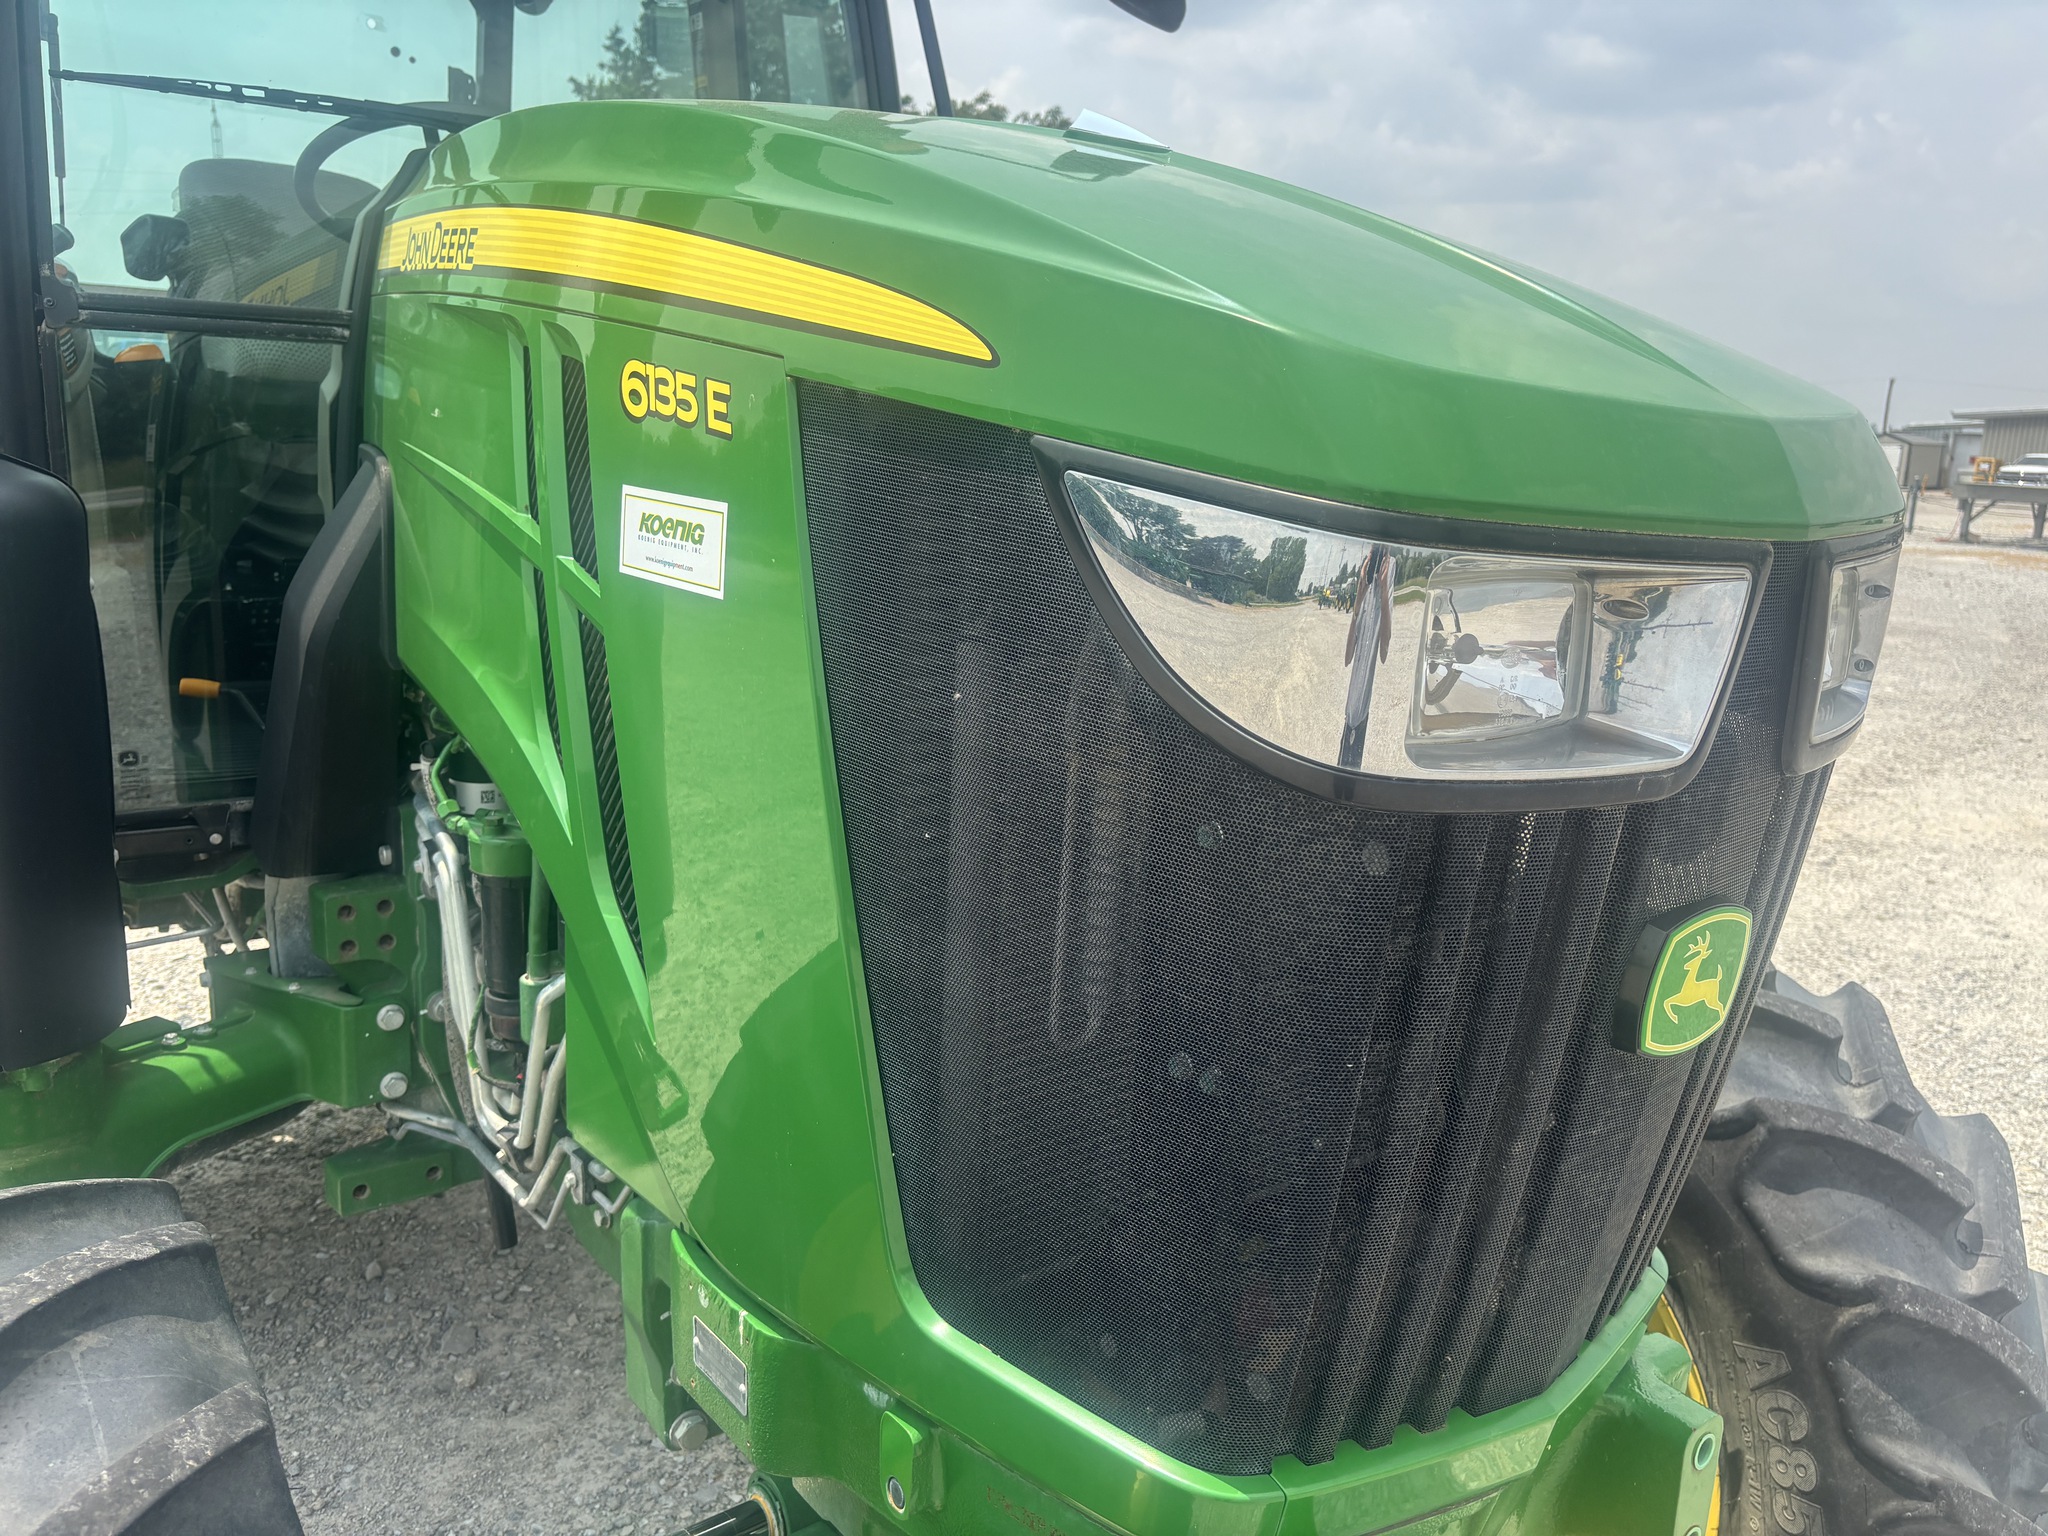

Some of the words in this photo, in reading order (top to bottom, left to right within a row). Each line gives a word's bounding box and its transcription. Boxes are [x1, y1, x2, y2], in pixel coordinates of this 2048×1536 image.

[400, 227, 432, 271] JOHN
[431, 221, 479, 270] DEERE
[620, 358, 699, 429] 6135
[703, 377, 734, 441] E
[637, 534, 656, 544] KOENIG
[1733, 1340, 1825, 1536] AC85
